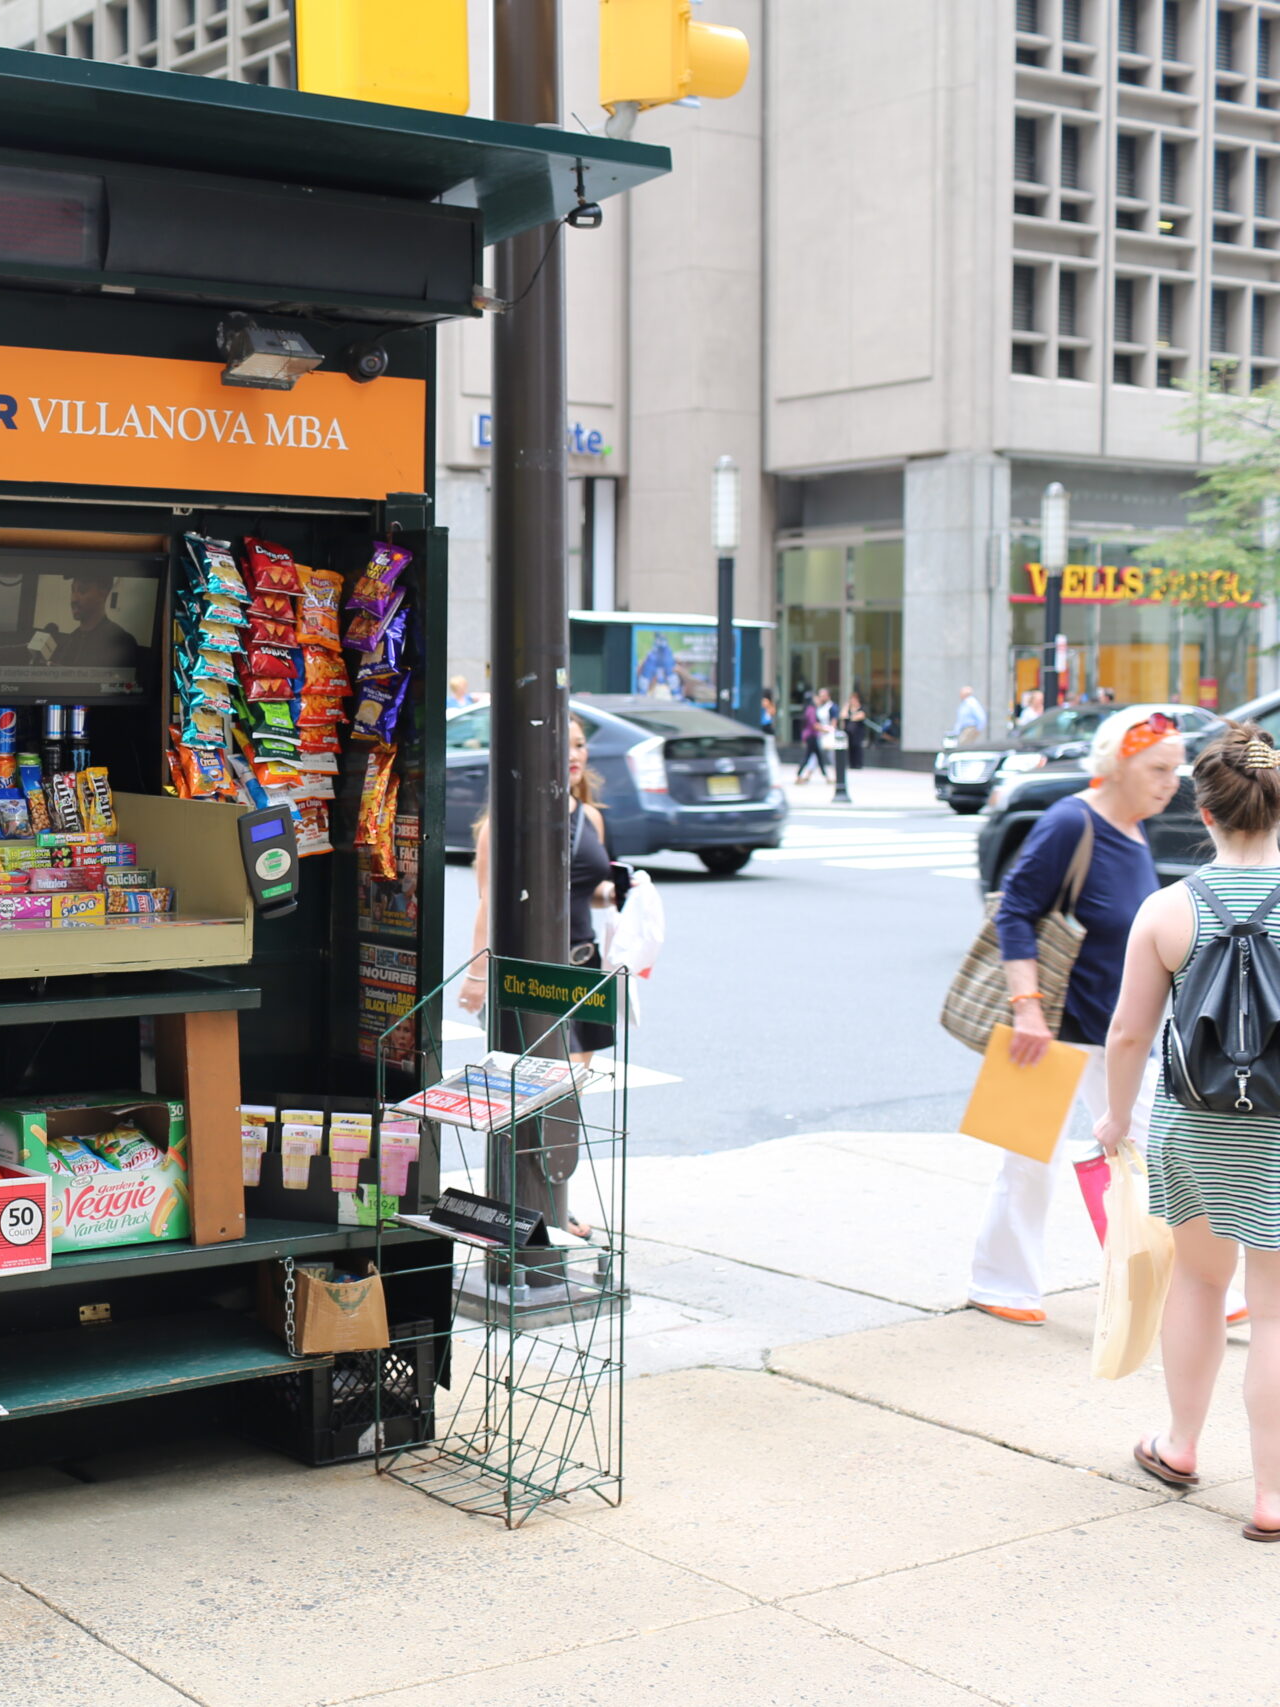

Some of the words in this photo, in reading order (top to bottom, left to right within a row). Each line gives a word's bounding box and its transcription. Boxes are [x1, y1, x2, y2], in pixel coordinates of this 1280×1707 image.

[27, 396, 256, 445] VILLANOVA
[263, 412, 349, 450] MBA
[255, 545, 290, 560] Doritos
[0, 685, 19, 693] Show
[306, 800, 322, 808] Chips
[61, 901, 97, 918] DOTS
[504, 975, 526, 995] The
[528, 978, 570, 1002] Boston
[572, 986, 606, 1008] Globe
[170, 1104, 184, 1117] 30
[95, 1180, 136, 1196] garden
[64, 1184, 156, 1227] Veggie
[8, 1207, 34, 1228] 50
[73, 1218, 119, 1239] Variety
[120, 1209, 151, 1230] Pack
[8, 1228, 35, 1238] Count
